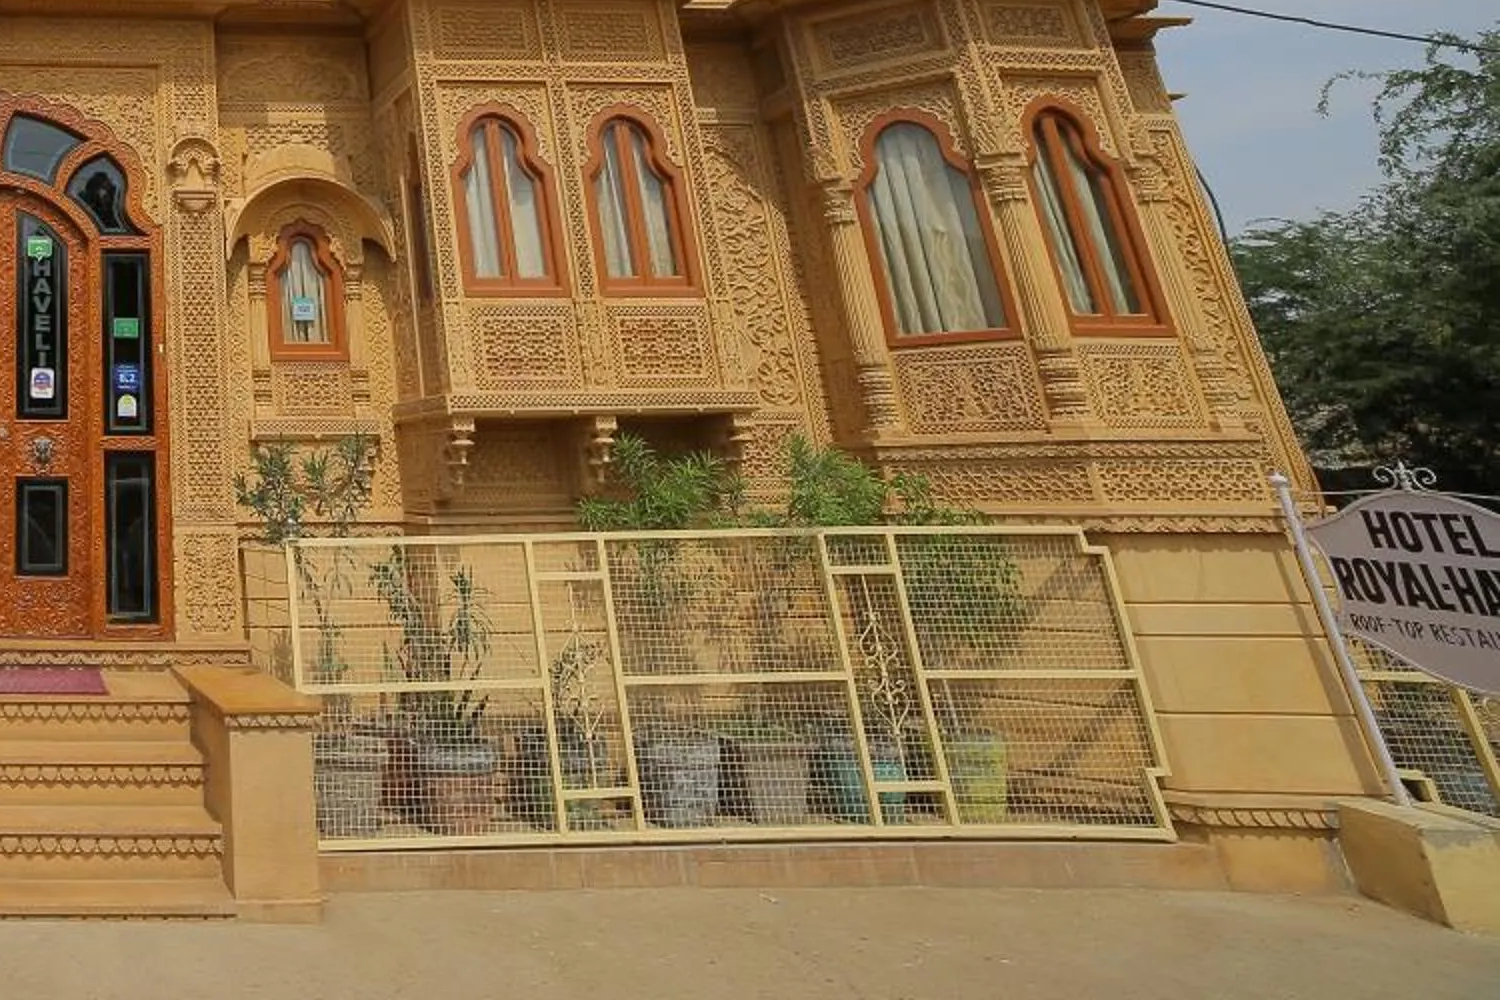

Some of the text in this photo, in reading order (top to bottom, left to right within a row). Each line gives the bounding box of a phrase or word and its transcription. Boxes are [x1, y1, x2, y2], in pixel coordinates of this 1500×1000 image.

[32, 259, 52, 366] HAVELI
[1360, 509, 1500, 558] HOTEL
[1329, 556, 1500, 617] ROYAL-HA
